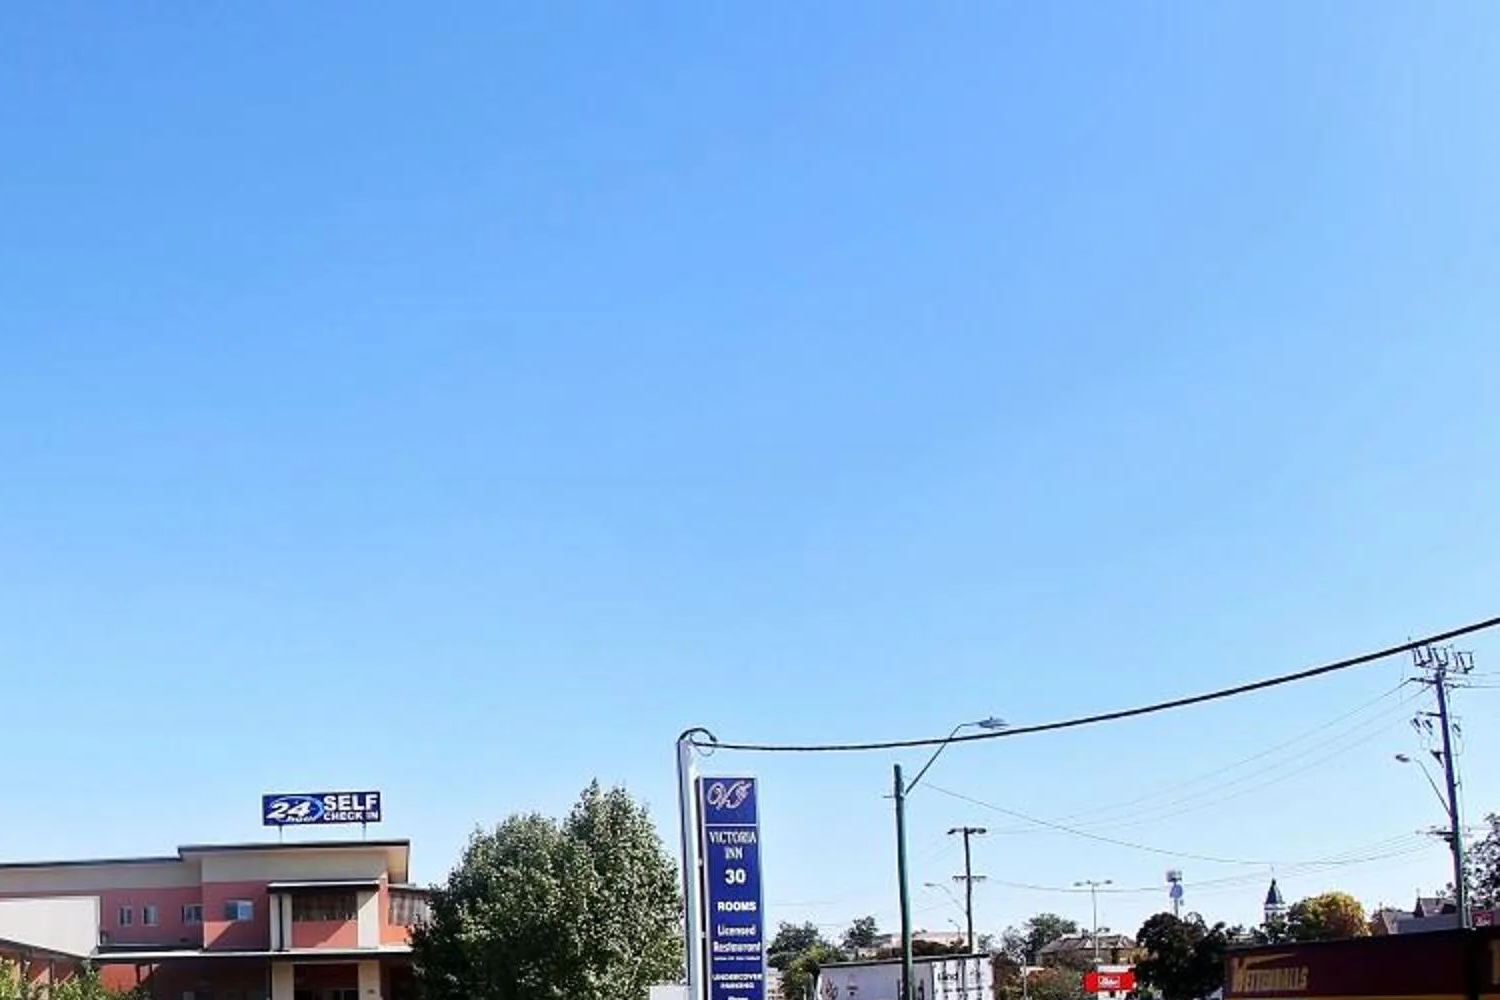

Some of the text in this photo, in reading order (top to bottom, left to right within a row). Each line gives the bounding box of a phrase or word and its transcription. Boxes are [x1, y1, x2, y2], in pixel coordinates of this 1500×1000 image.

[323, 794, 378, 811] SELF
[266, 801, 311, 819] 24
[323, 811, 379, 821] CHECK IN
[709, 831, 757, 844] VICTORIA
[724, 846, 743, 860] INN
[725, 869, 746, 885] 30
[717, 901, 757, 912] ROOMS
[717, 924, 757, 937] Licensed
[713, 941, 761, 953] Restaurant
